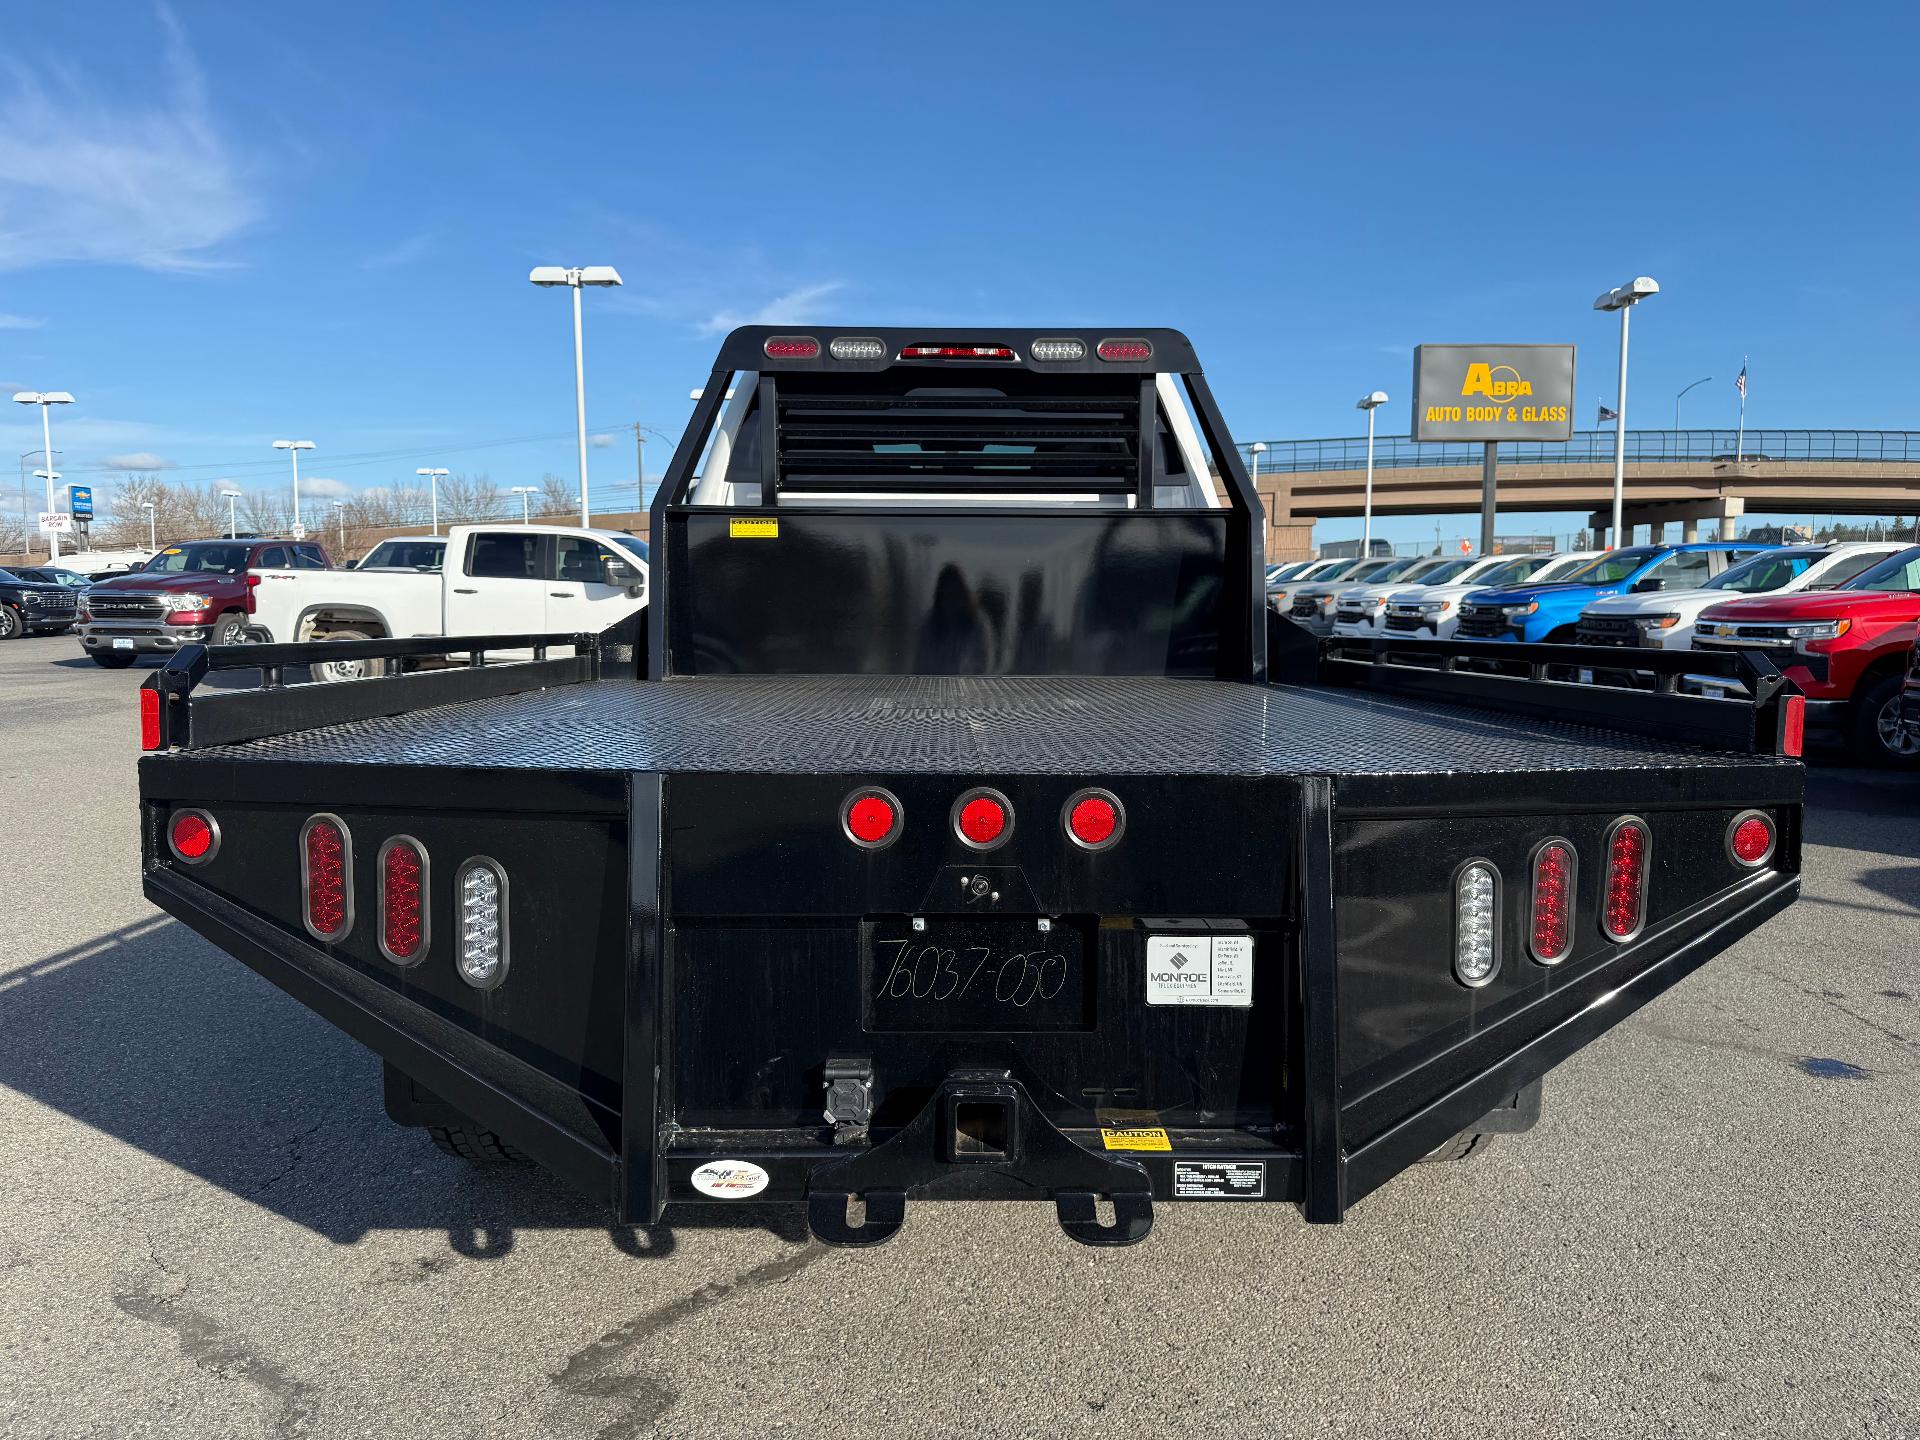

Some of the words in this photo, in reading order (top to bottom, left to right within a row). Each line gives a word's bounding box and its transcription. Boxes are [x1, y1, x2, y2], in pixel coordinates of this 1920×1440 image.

[1461, 362, 1533, 396] ABRA
[1425, 406, 1461, 422] AUTO
[1466, 406, 1503, 422] BODY
[1506, 407, 1518, 422] &
[1522, 406, 1567, 422] GLASS
[41, 515, 68, 523] BARGAIN
[876, 939, 1067, 1007] 76037-050
[1150, 972, 1207, 982] MONROE
